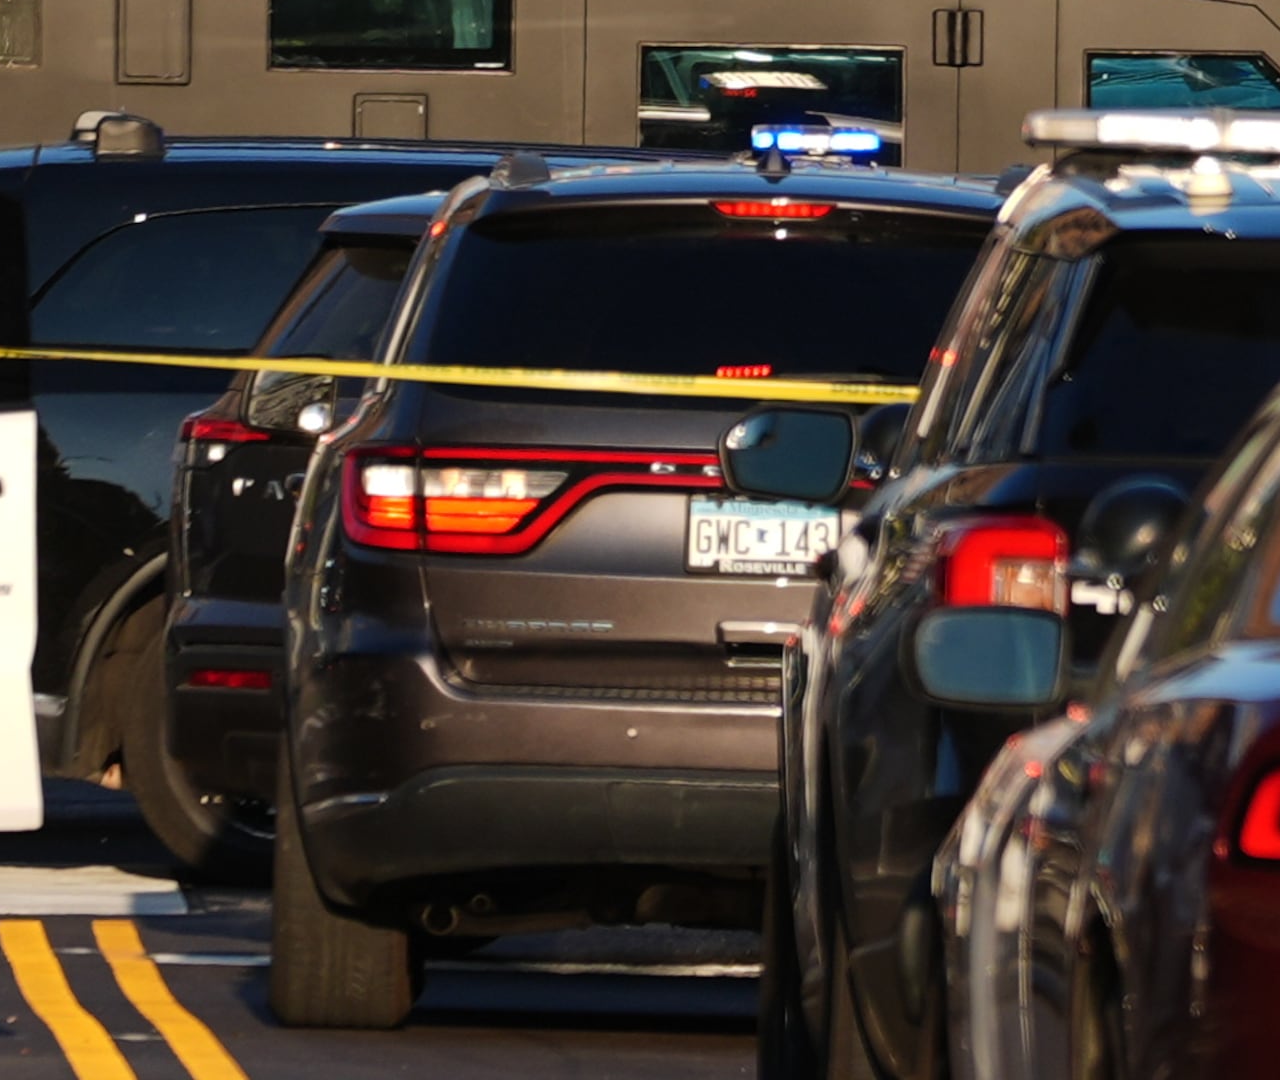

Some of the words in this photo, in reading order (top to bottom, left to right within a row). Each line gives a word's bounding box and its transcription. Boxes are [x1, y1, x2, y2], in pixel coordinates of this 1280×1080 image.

[696, 519, 751, 555] GWC
[775, 520, 831, 557] 143
[719, 561, 807, 575] ROSEVILLE
